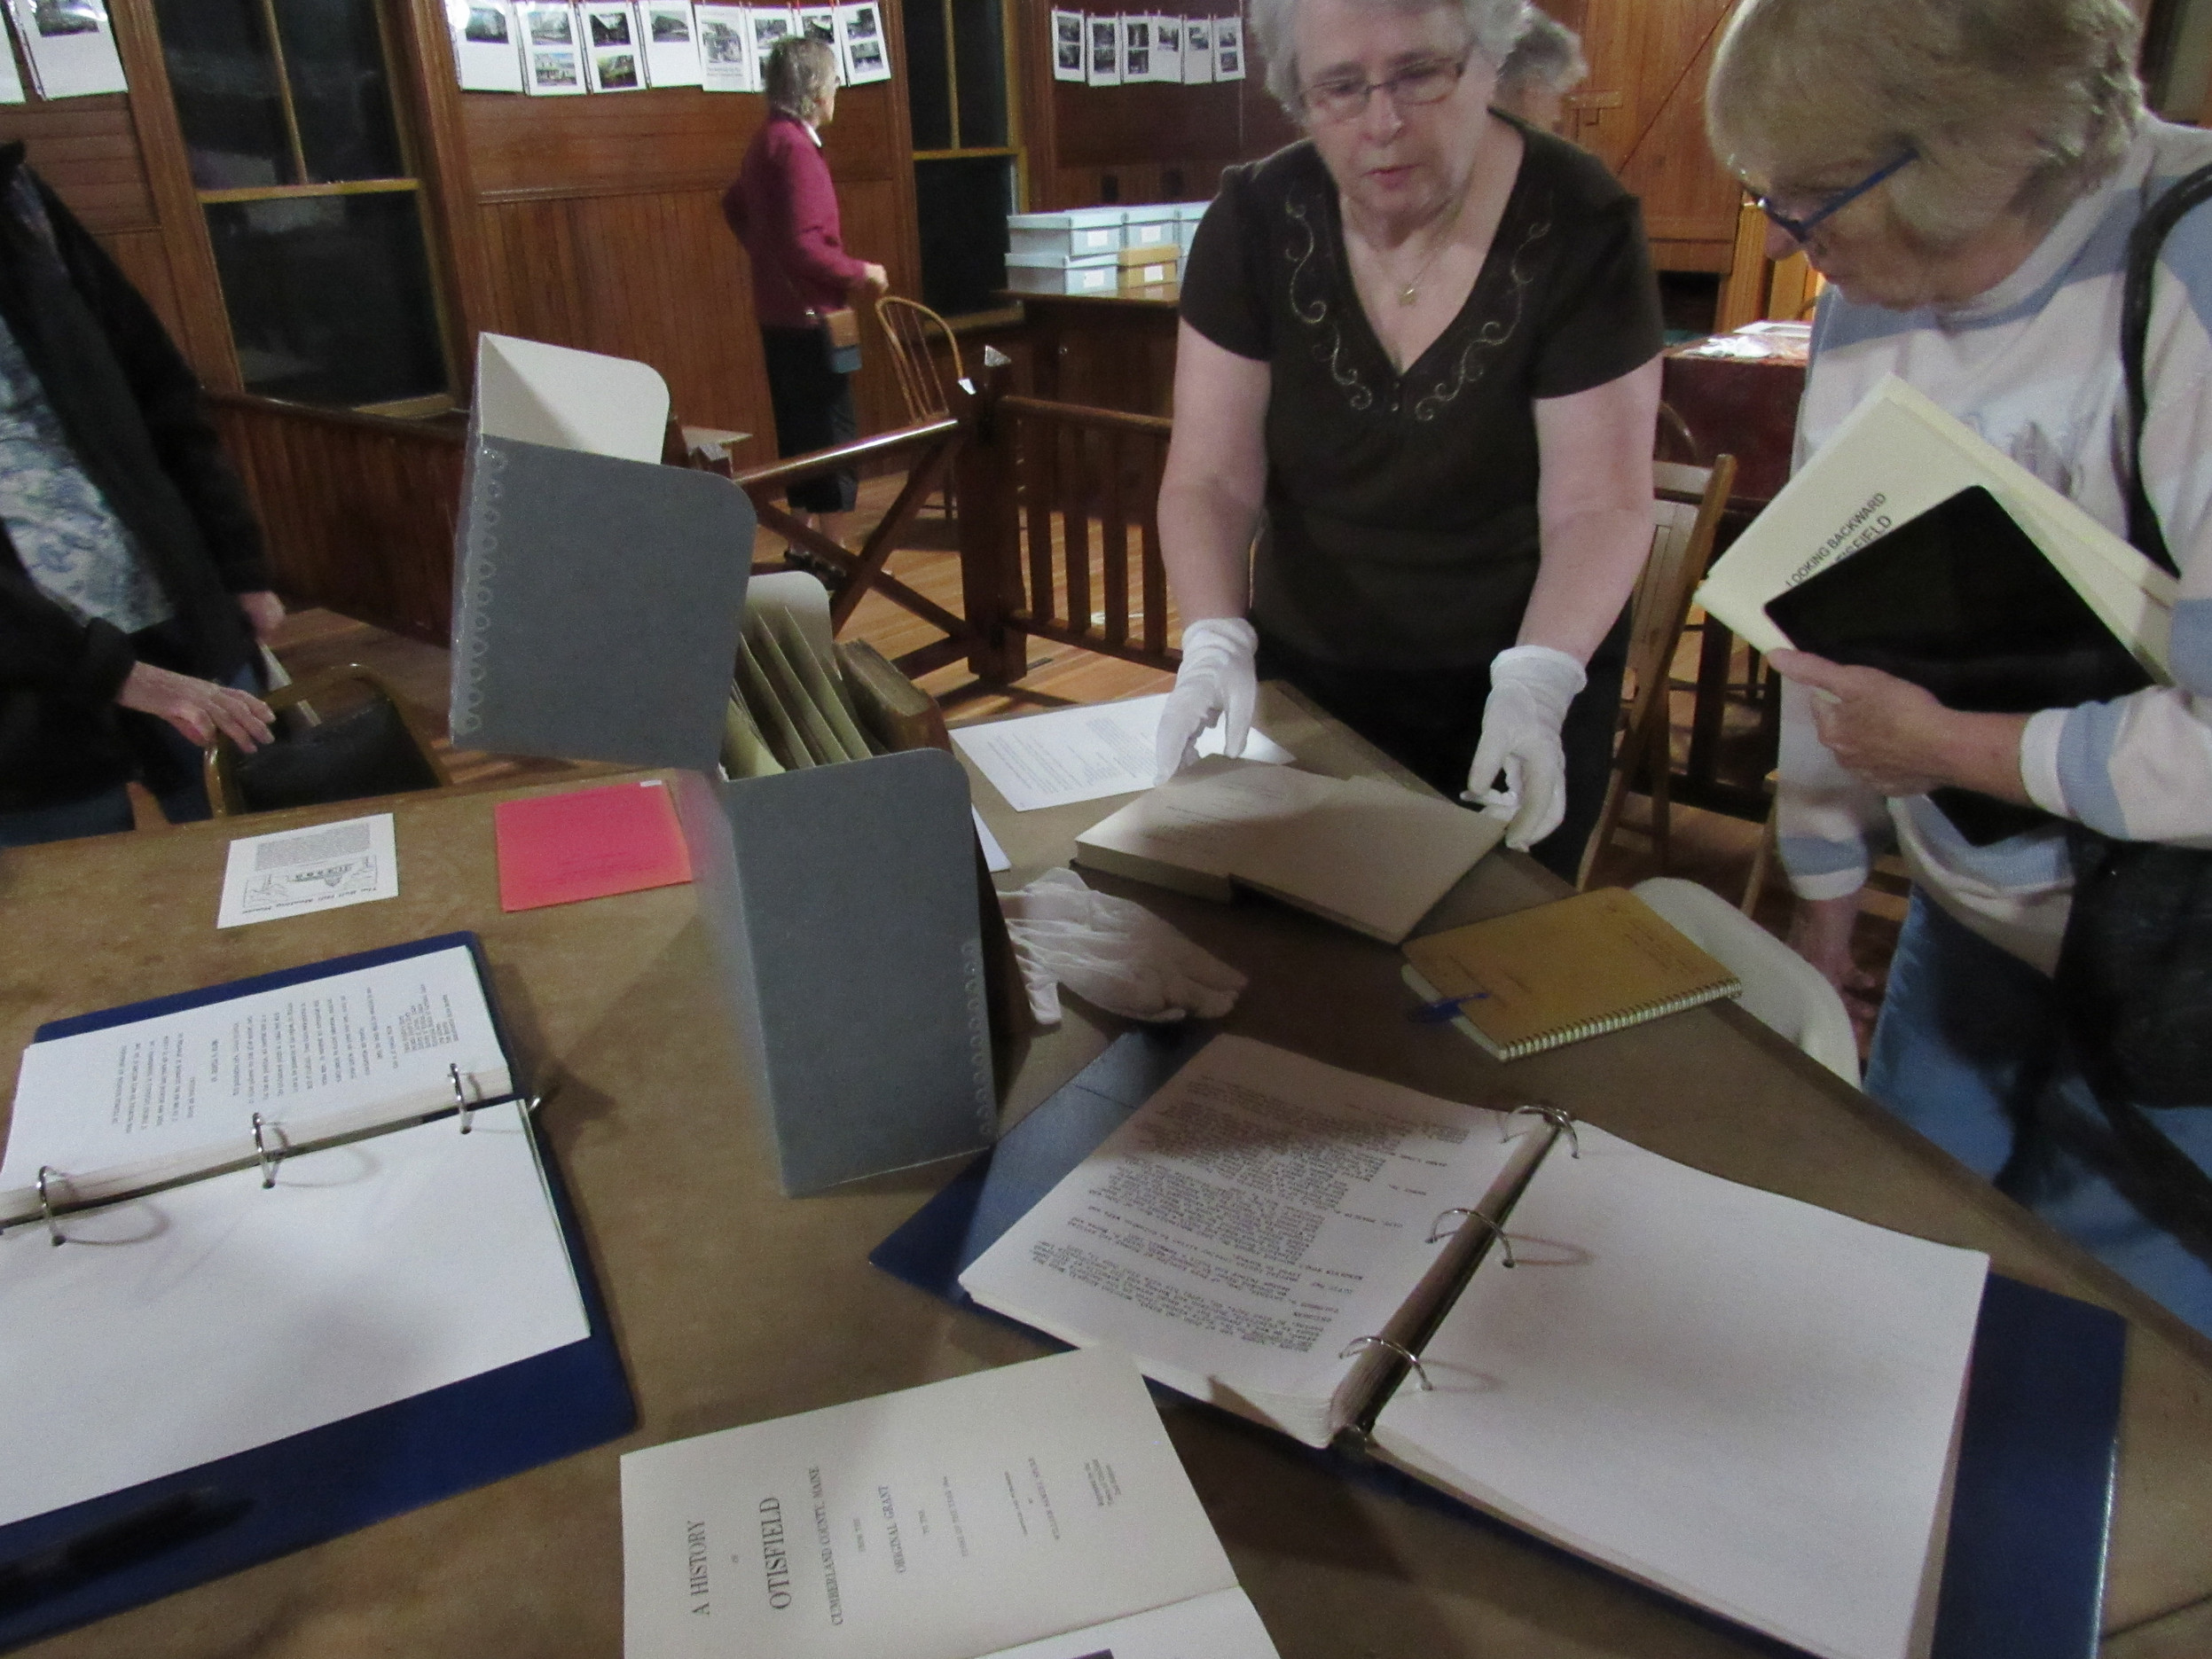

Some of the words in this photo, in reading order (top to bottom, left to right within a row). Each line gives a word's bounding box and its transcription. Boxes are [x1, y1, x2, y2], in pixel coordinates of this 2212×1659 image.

[1785, 546, 1831, 587] LOOKING
[1826, 493, 1886, 550] BACKWARD
[1833, 514, 1893, 562] ISFIELD
[808, 1466, 823, 1499] MAINE
[878, 1484, 895, 1519] GRANT
[687, 1520, 710, 1597] HISTORY
[759, 1497, 792, 1609] OTISFIELD
[887, 1522, 906, 1574] ORIGINAL
[691, 1601, 710, 1616] A
[821, 1547, 843, 1625] CUMBERLAND
